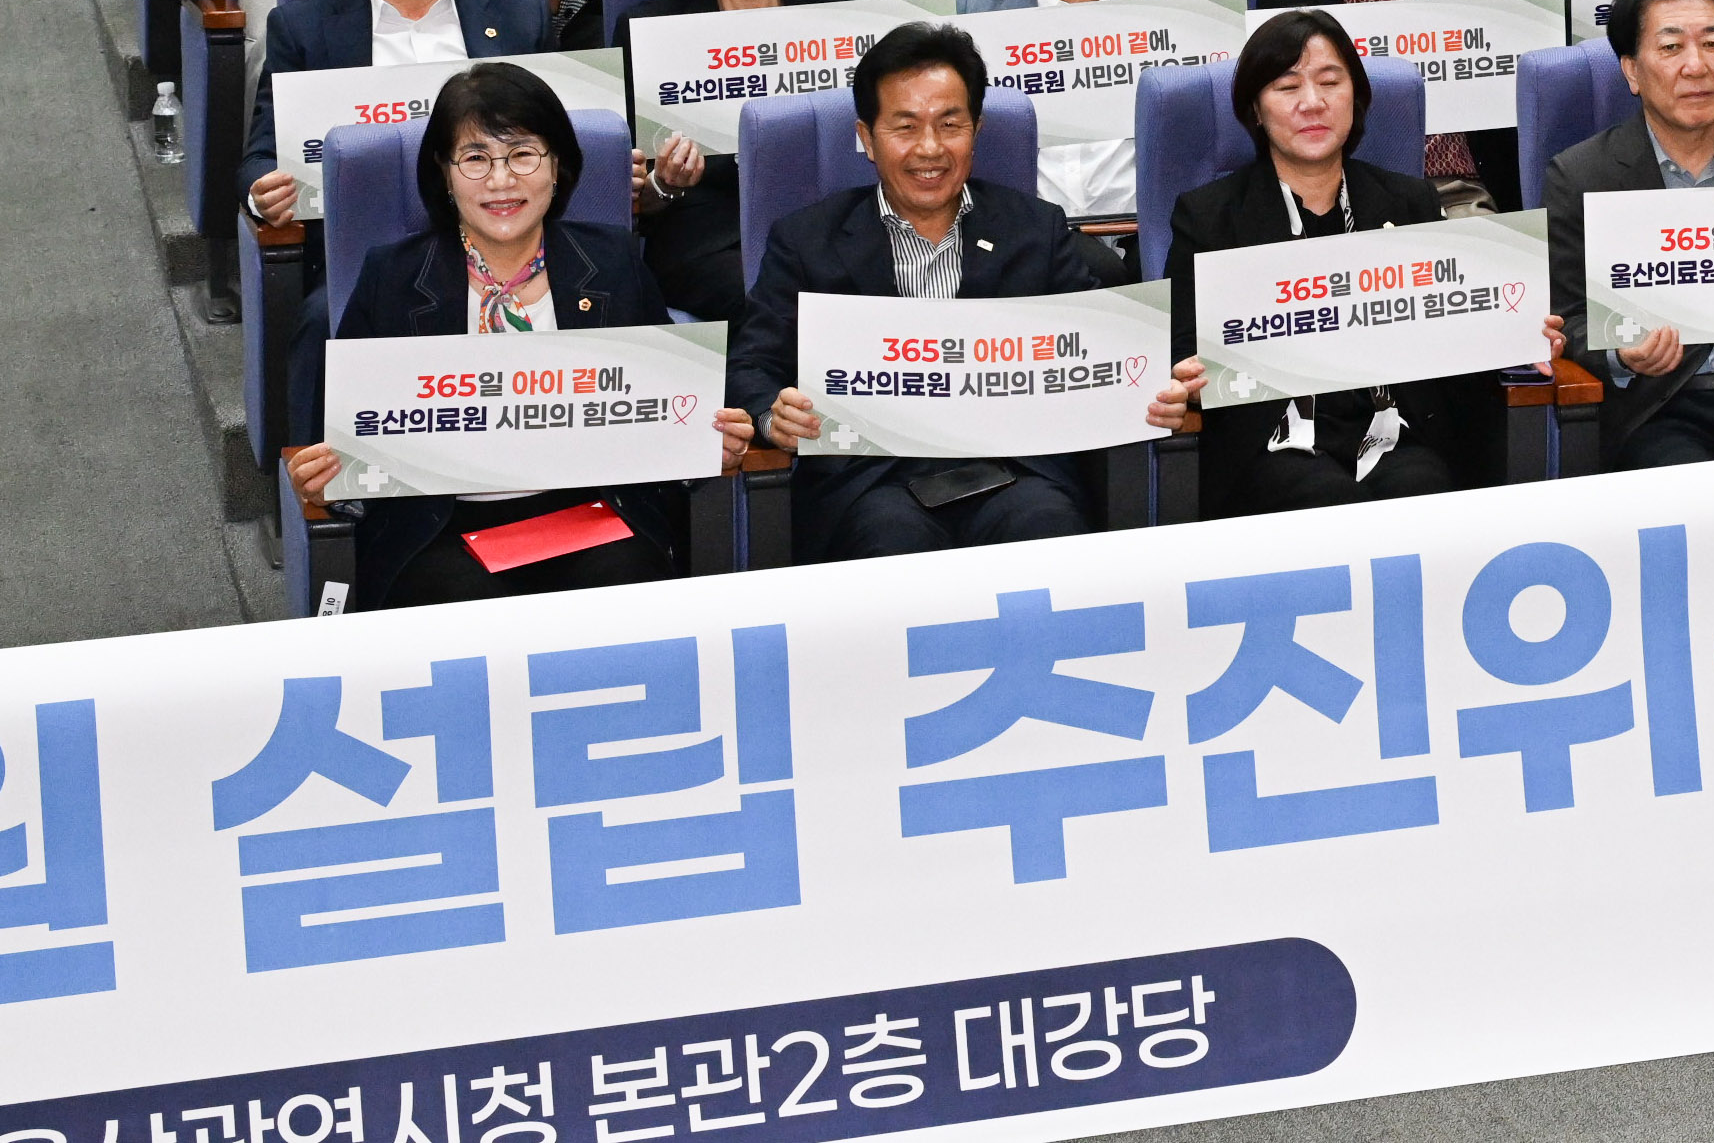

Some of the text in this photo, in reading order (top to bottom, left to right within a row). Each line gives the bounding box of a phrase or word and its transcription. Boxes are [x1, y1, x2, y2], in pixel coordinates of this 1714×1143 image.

[882, 331, 1088, 363] 365일 아이 곁에,
[416, 366, 632, 399] 365일 아이 곁에,
[824, 365, 1122, 397] 울산의료원 시민의 힘으로!
[354, 398, 668, 437] 울산의료원 시민의 힘으로!
[211, 623, 801, 973] 설립
[588, 1013, 927, 1143] 본관2층
[954, 975, 1215, 1091] 대강당
